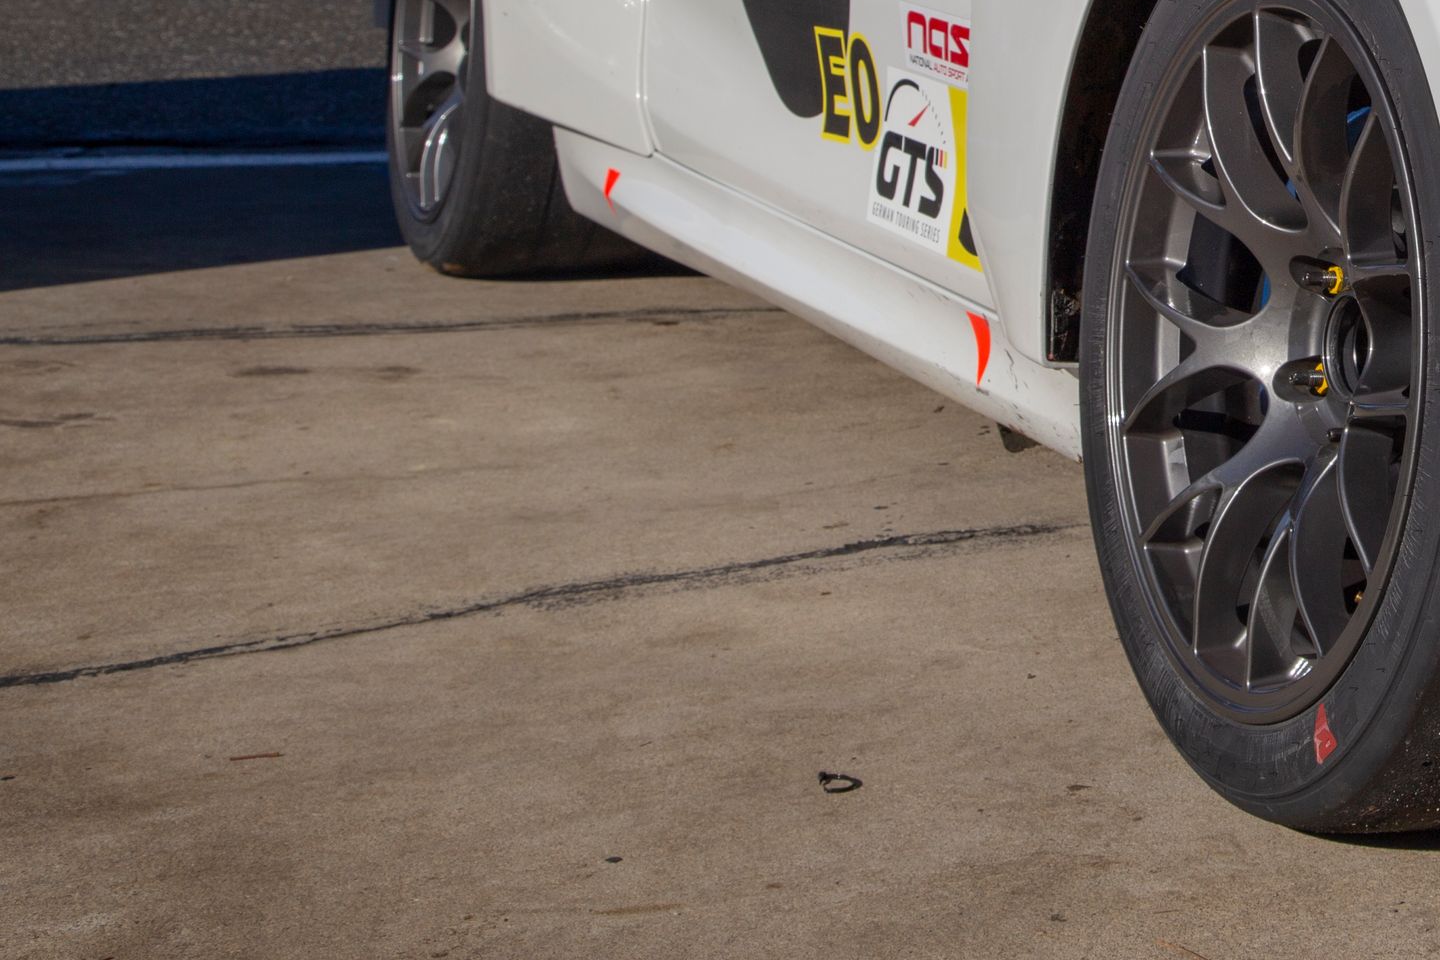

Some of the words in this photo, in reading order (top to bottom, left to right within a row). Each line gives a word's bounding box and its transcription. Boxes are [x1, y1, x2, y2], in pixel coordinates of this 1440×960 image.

[876, 130, 944, 219] GTS
[871, 201, 895, 222] GERMAN
[895, 211, 920, 234] TOURING
[919, 223, 941, 244] SERIES
